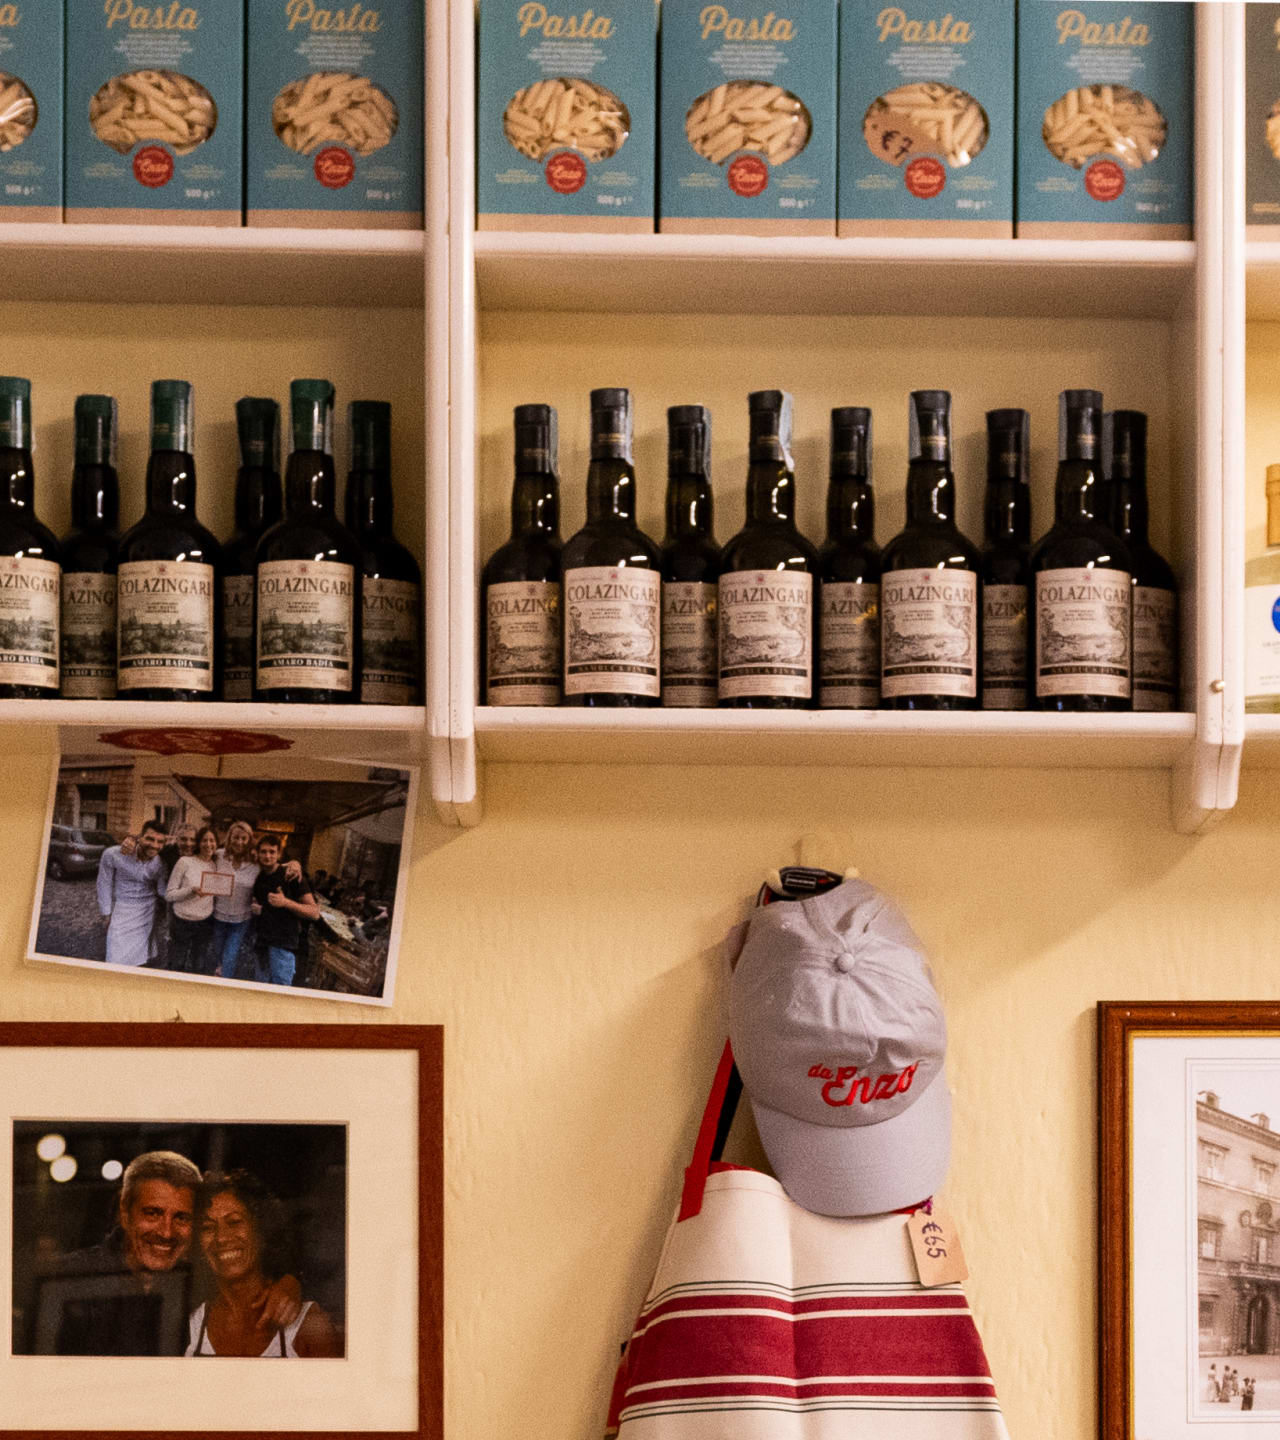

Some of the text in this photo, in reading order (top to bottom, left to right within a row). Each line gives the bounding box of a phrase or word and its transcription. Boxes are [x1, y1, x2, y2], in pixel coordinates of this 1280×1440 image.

[104, 0, 205, 30] Pasta
[296, 0, 394, 31] Pasta
[517, 2, 617, 39] Pasta
[699, 5, 798, 41] Pasta
[877, 7, 976, 43] Pasta
[1056, 10, 1153, 46] Pasta
[120, 577, 211, 596] COLAZINGARI
[259, 577, 352, 596] COLAZINGARI
[567, 585, 659, 603] COLAZINGARI
[720, 584, 810, 605] COLAZINGARI
[884, 585, 974, 604] COLAZINGARI
[821, 1060, 921, 1107] Enzo
